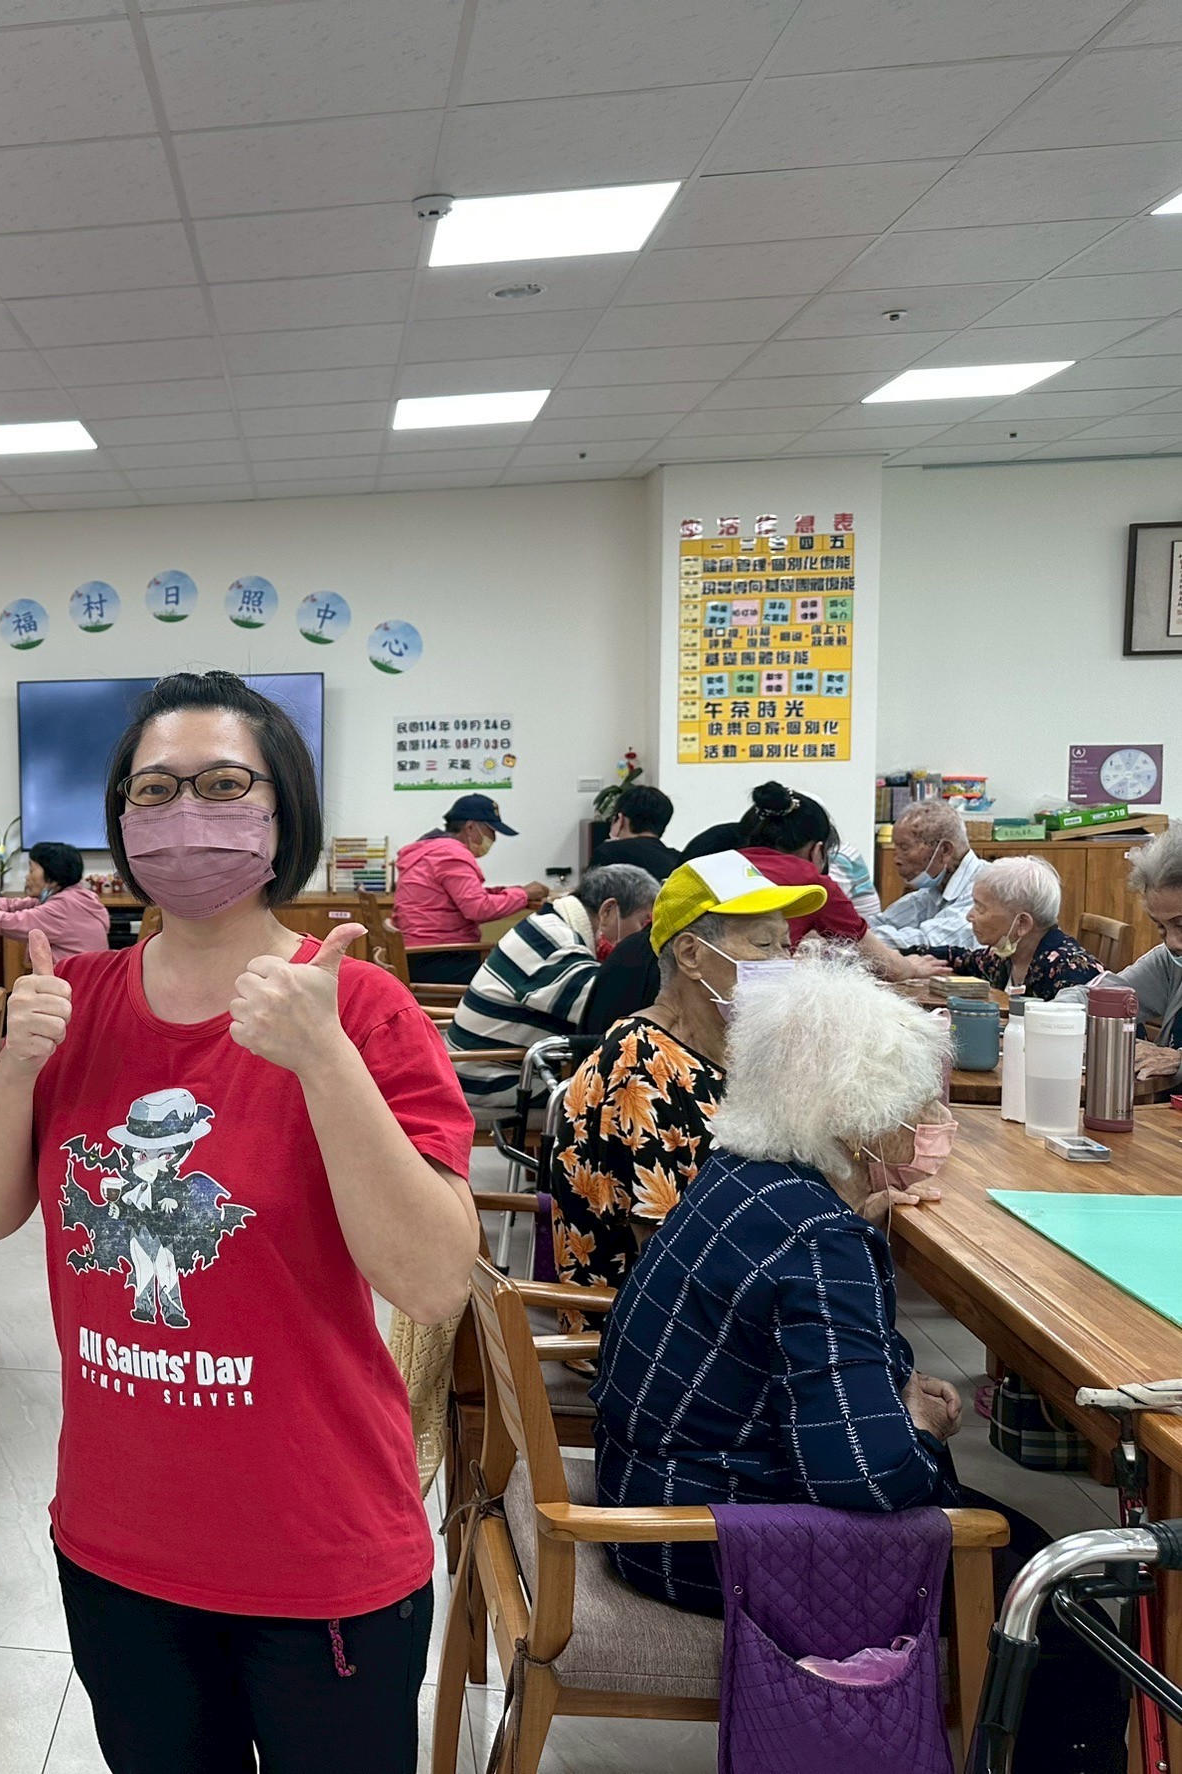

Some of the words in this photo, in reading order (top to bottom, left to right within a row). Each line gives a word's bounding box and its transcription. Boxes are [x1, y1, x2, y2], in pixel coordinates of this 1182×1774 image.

[799, 536, 814, 549] 四
[830, 535, 845, 549] 五
[704, 701, 804, 719] 午茶時光
[79, 1326, 104, 1366] All
[105, 1337, 191, 1385] Saints'
[196, 1350, 254, 1386] Day
[81, 1364, 135, 1398] DEMON
[163, 1389, 254, 1407] SLAYER
